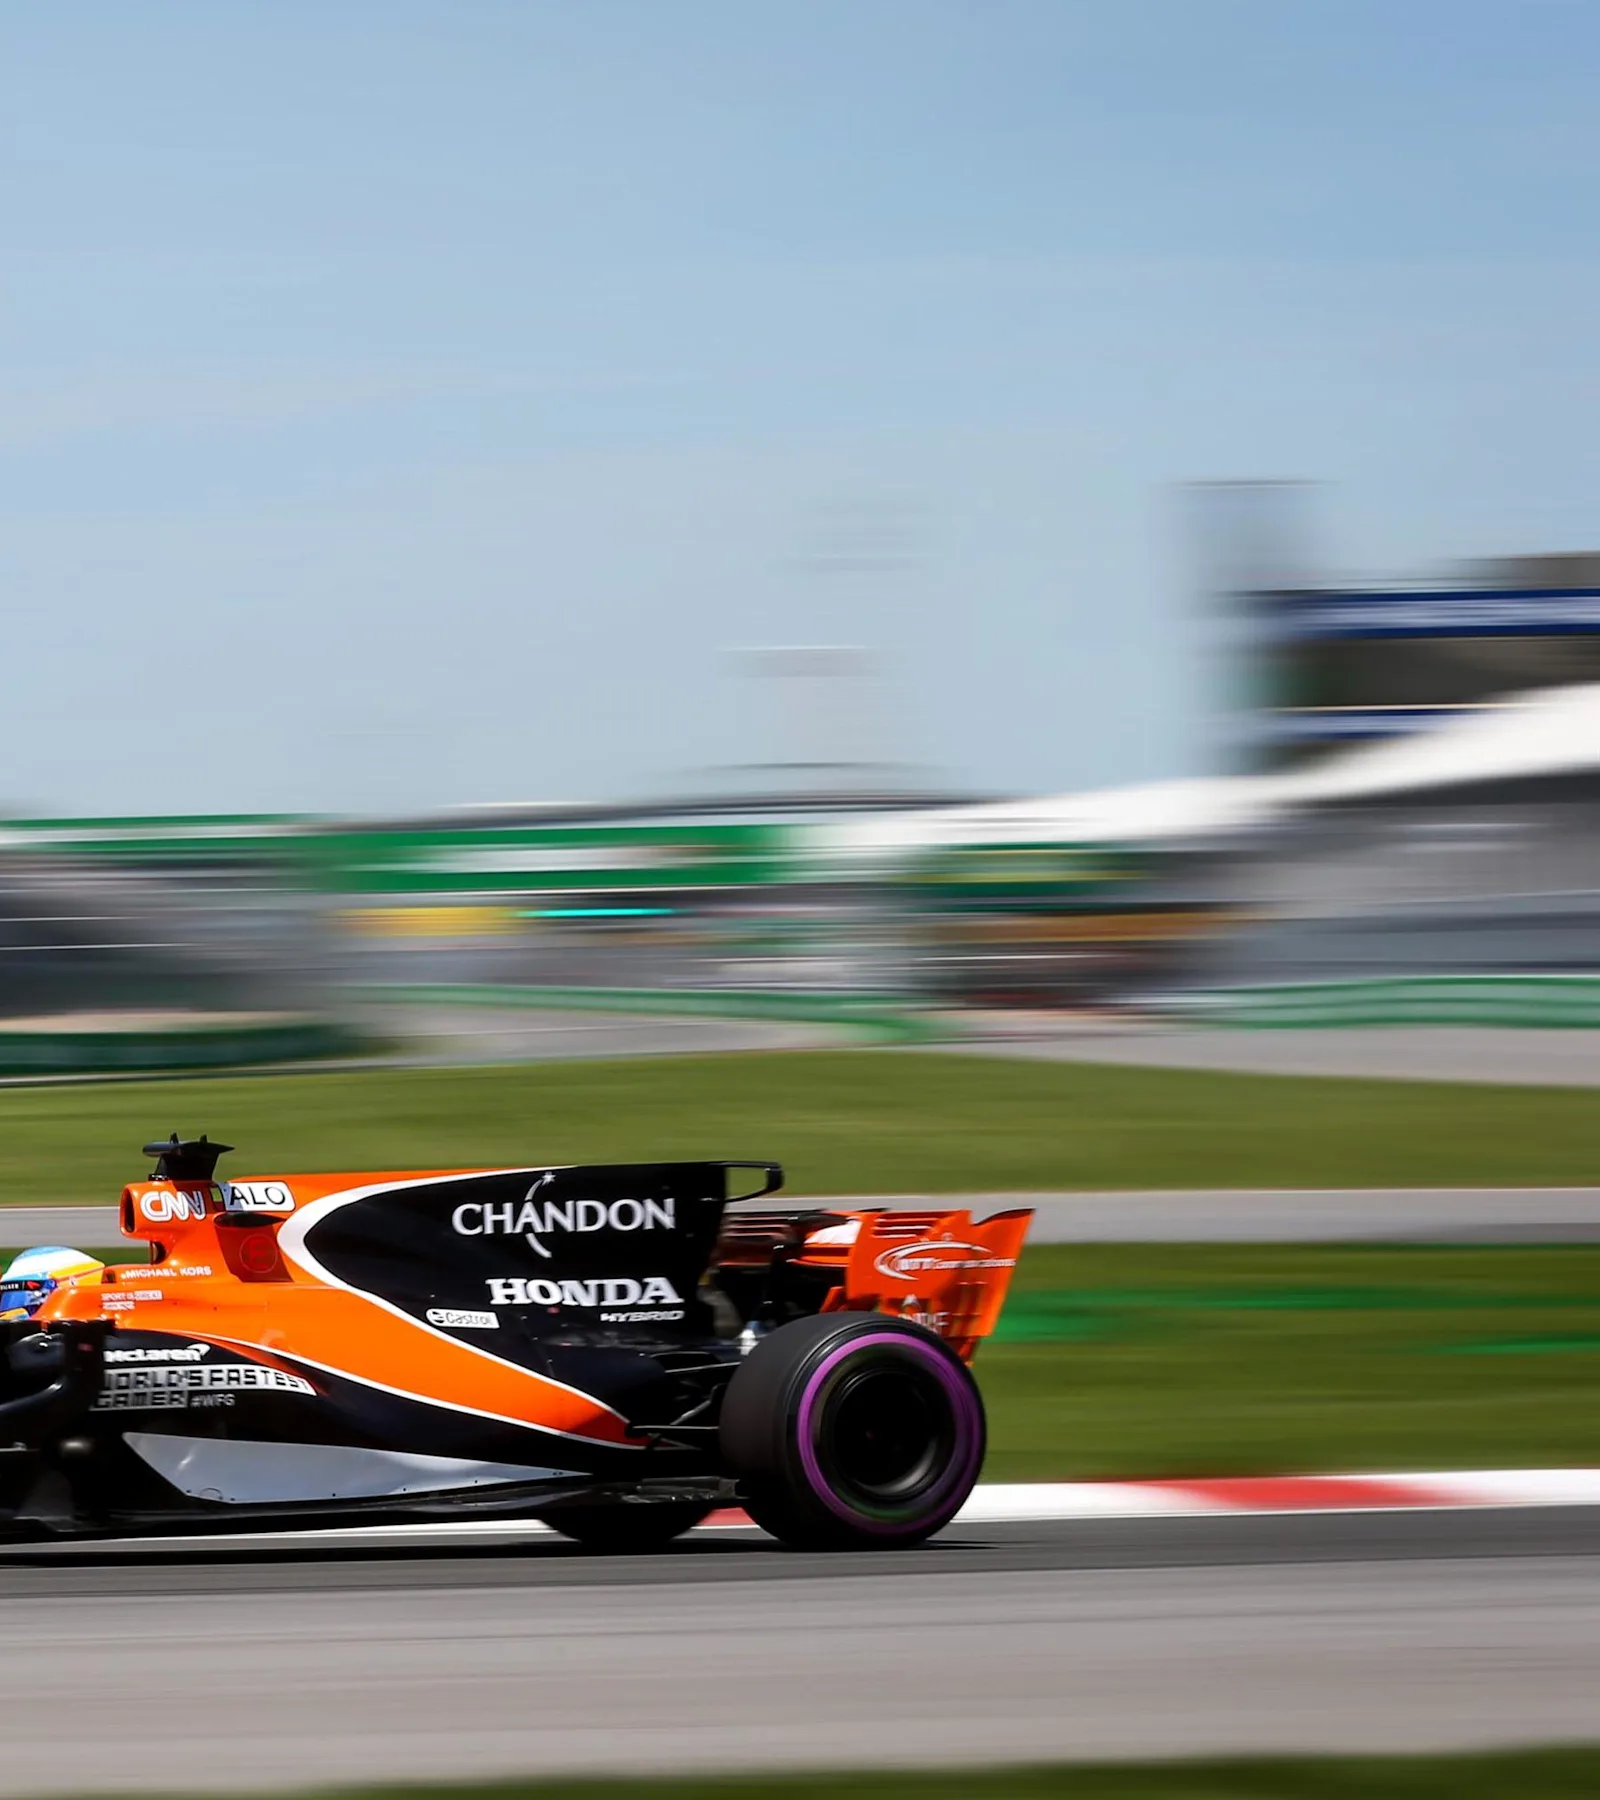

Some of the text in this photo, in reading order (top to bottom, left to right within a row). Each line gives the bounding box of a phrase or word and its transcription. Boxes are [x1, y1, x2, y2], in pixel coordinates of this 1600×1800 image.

[229, 1186, 286, 1205] ALO
[140, 1191, 206, 1221] CNN
[451, 1198, 676, 1236] CHANDON
[125, 1265, 212, 1279] MICHAEL KORS
[485, 1276, 685, 1306] HONDA
[445, 1312, 493, 1325] Castrol
[600, 1310, 685, 1322] HYBRID
[103, 1347, 202, 1363] McLaren
[209, 1368, 310, 1391] FASTEST
